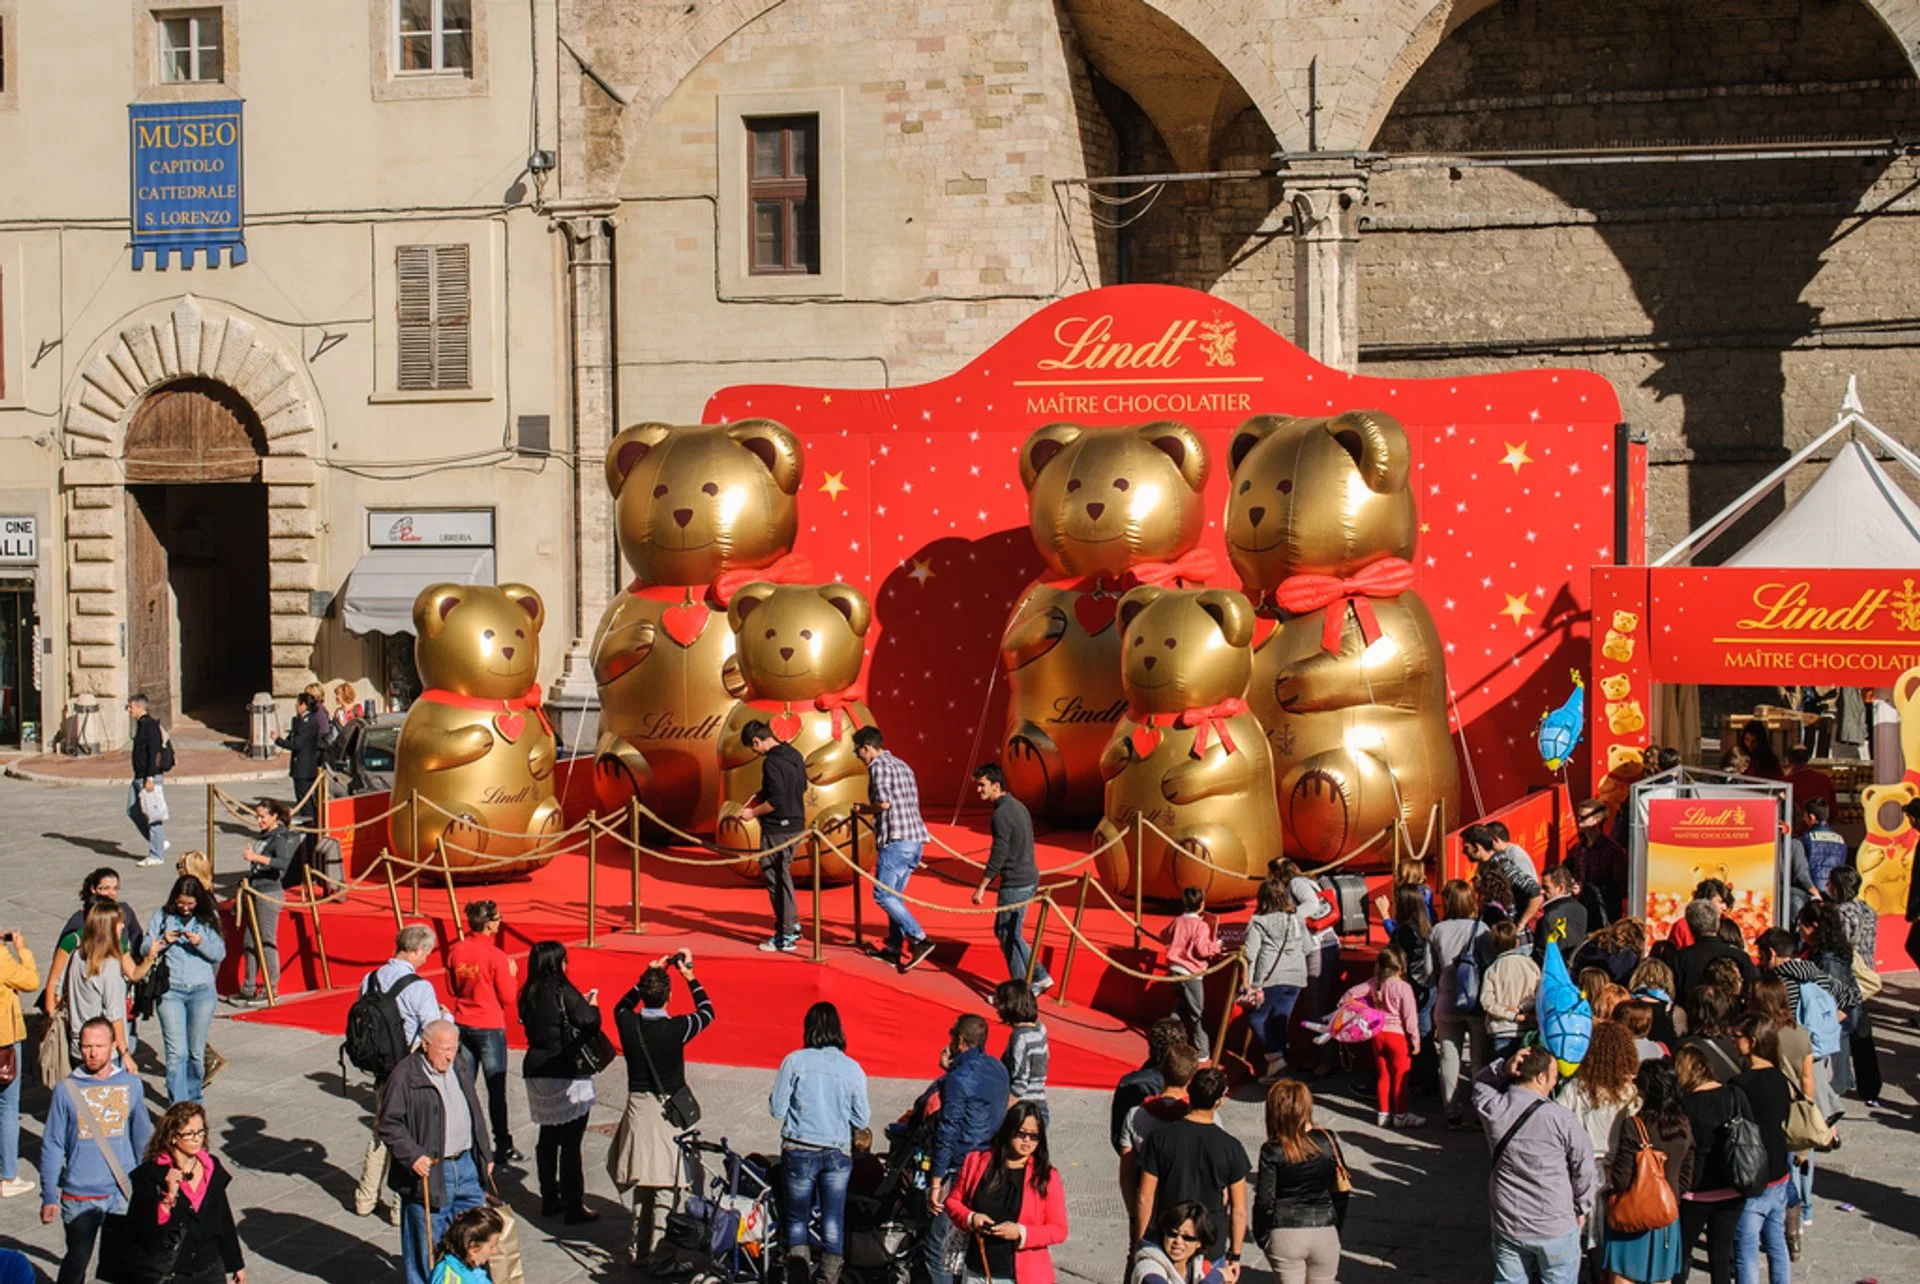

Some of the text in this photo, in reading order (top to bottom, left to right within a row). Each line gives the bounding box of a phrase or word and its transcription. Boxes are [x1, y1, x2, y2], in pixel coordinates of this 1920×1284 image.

[138, 122, 236, 149] MUSEO
[149, 159, 224, 174] CAPITOLO
[138, 185, 236, 201] CATTEDRALE
[144, 211, 232, 226] S. LORENZO
[1037, 314, 1198, 371] Lindt
[1025, 392, 1251, 414] MAÎTRE CHOCOLATIER
[5, 521, 32, 534] CINE
[0, 539, 33, 556] LLI
[1736, 581, 1891, 632] Lindt
[1724, 648, 1795, 669] MAÎTRE
[637, 711, 722, 740] Lindt
[479, 785, 530, 804] Lindt
[1680, 806, 1733, 826] Lindt
